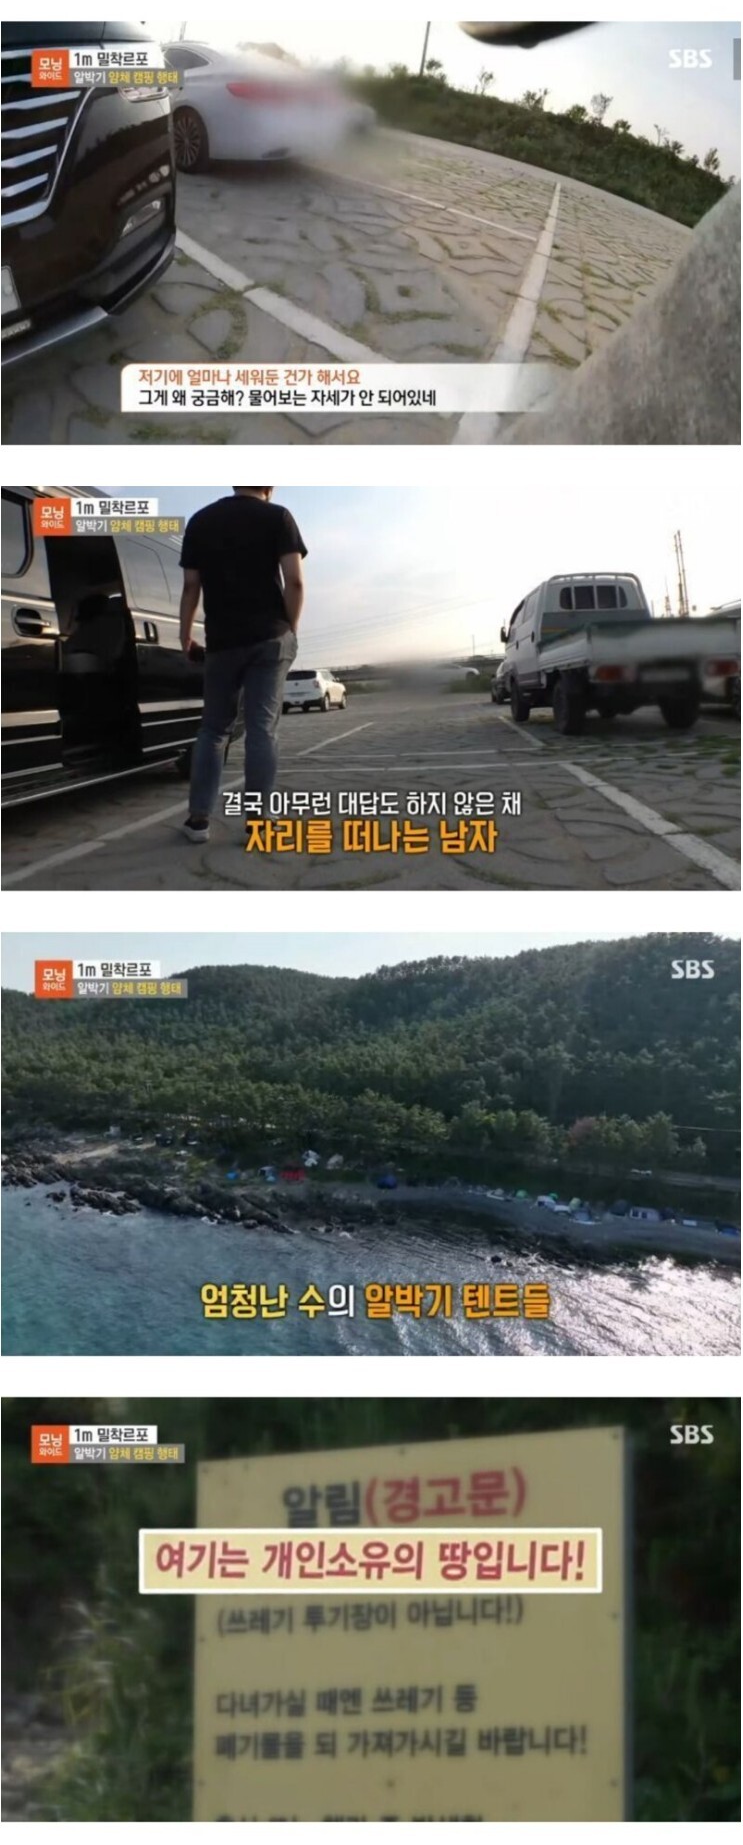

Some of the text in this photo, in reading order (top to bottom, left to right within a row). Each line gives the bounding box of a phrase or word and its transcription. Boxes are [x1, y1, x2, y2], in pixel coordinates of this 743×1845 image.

[282, 1467, 526, 1528] 알림(경고문)
[156, 1540, 585, 1582] 여기는 개인소유의 땅입니다!
